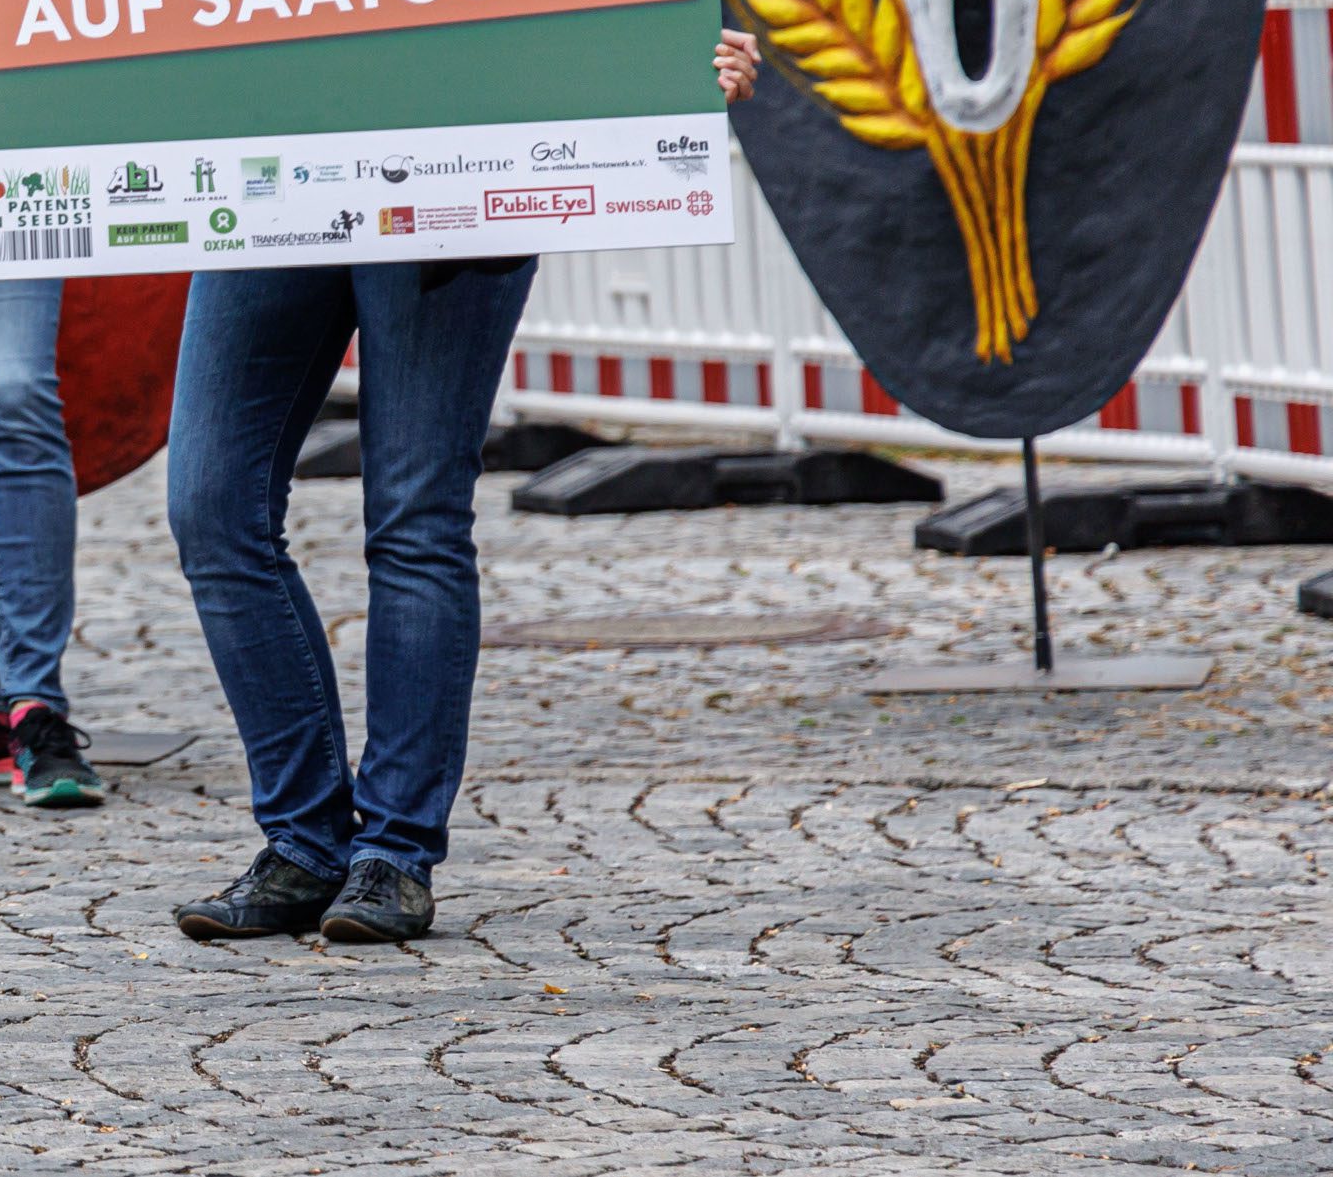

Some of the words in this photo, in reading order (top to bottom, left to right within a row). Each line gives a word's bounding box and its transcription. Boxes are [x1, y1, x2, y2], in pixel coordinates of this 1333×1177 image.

[531, 140, 577, 161] GeN
[657, 135, 709, 153] Gegen
[532, 163, 591, 172] Gen-ethisches
[591, 160, 630, 169] Netzwerk
[632, 159, 647, 168] e.V.
[9, 198, 91, 213] PATENTS
[491, 195, 548, 213] Public
[552, 193, 588, 211] Eye
[605, 198, 682, 214] SWISSAID
[18, 212, 92, 227] SEEDS!
[142, 223, 179, 234] PATENT
[204, 238, 245, 252] OXFAM
